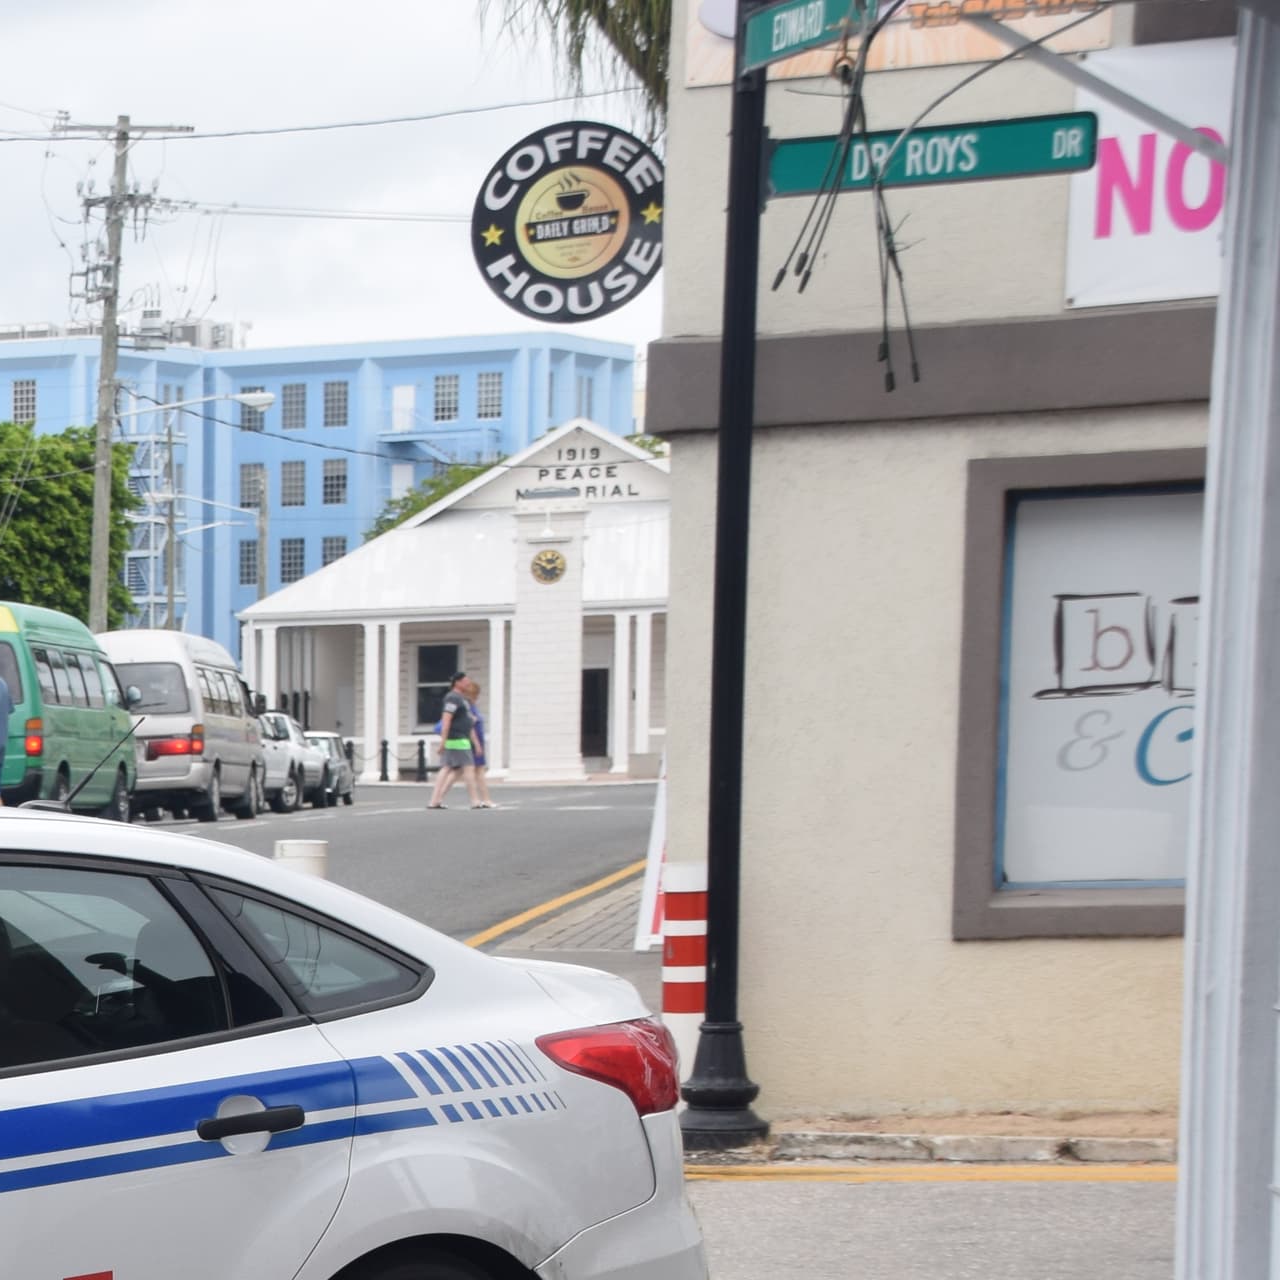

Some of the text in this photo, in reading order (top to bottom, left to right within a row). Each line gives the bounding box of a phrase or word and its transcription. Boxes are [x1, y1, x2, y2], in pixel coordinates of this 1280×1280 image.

[772, 1, 824, 52] EDWARD
[484, 129, 663, 211] COFFEE
[851, 127, 1084, 182] DR ROYS DR
[536, 215, 610, 240] DAILY GRIND
[486, 238, 662, 315] HOUSE
[538, 466, 618, 481] PEACE
[557, 447, 601, 461] 1919
[1056, 709, 1125, 772] &
